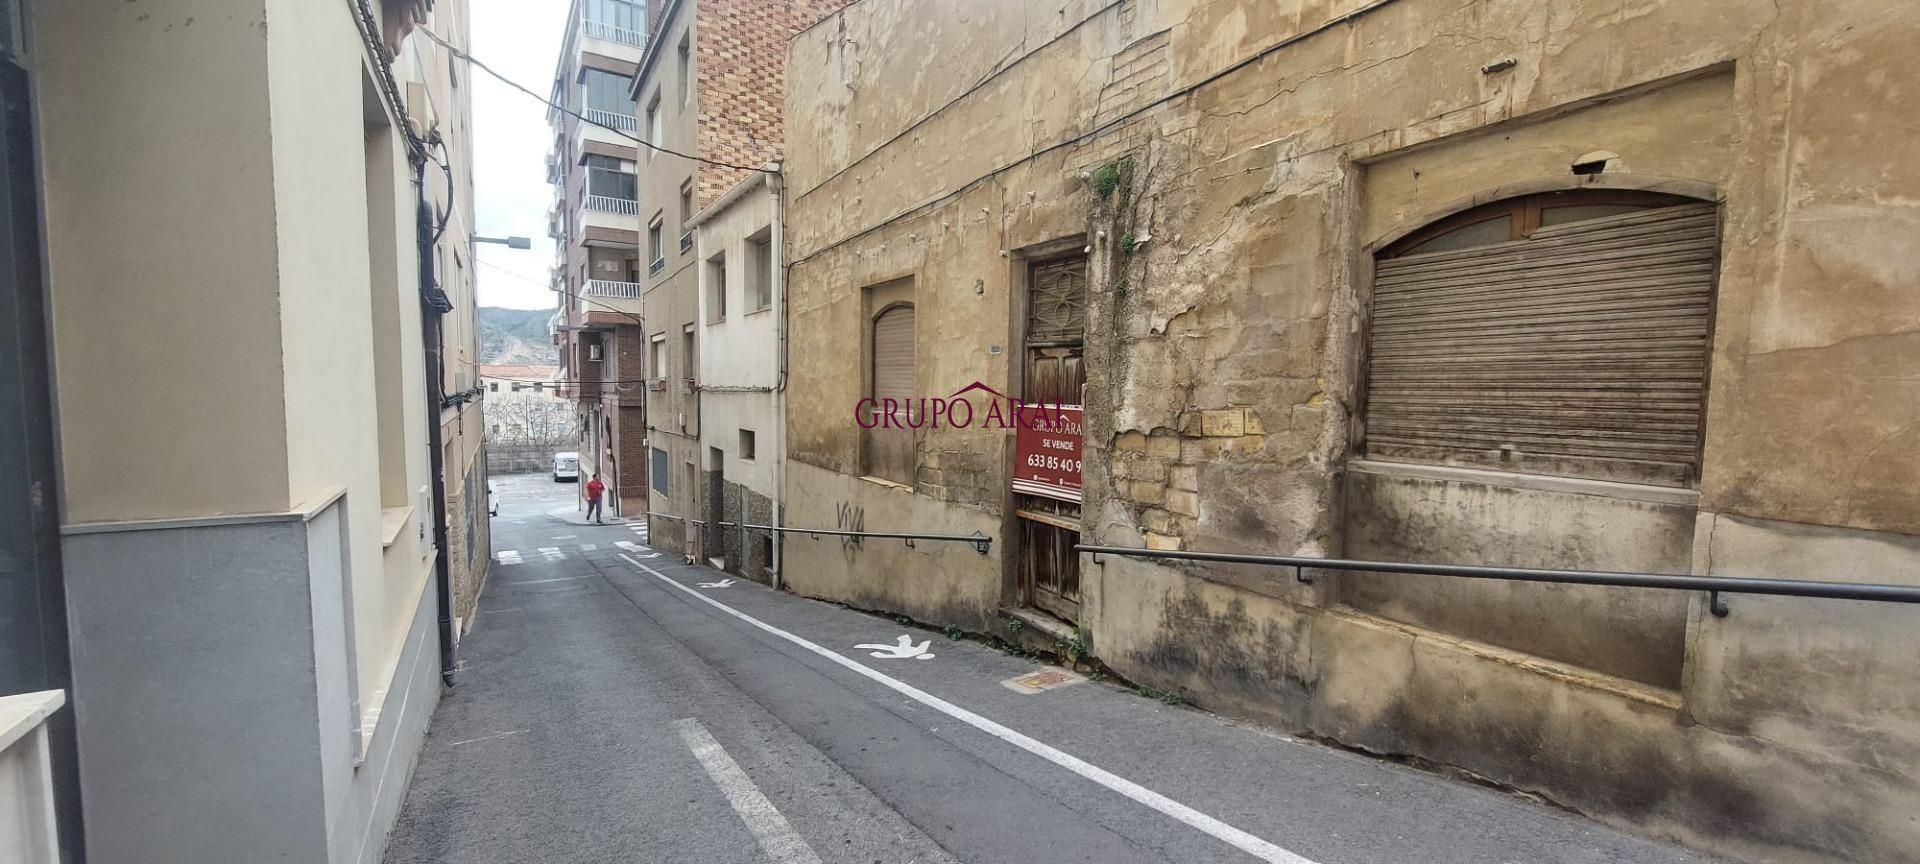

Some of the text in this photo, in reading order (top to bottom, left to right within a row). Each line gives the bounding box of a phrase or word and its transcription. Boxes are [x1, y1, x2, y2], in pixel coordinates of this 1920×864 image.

[1033, 418, 1082, 435] GRUPO ARA
[1042, 438, 1074, 451] SE VENDE
[1028, 454, 1082, 473] 633 85 40 9
